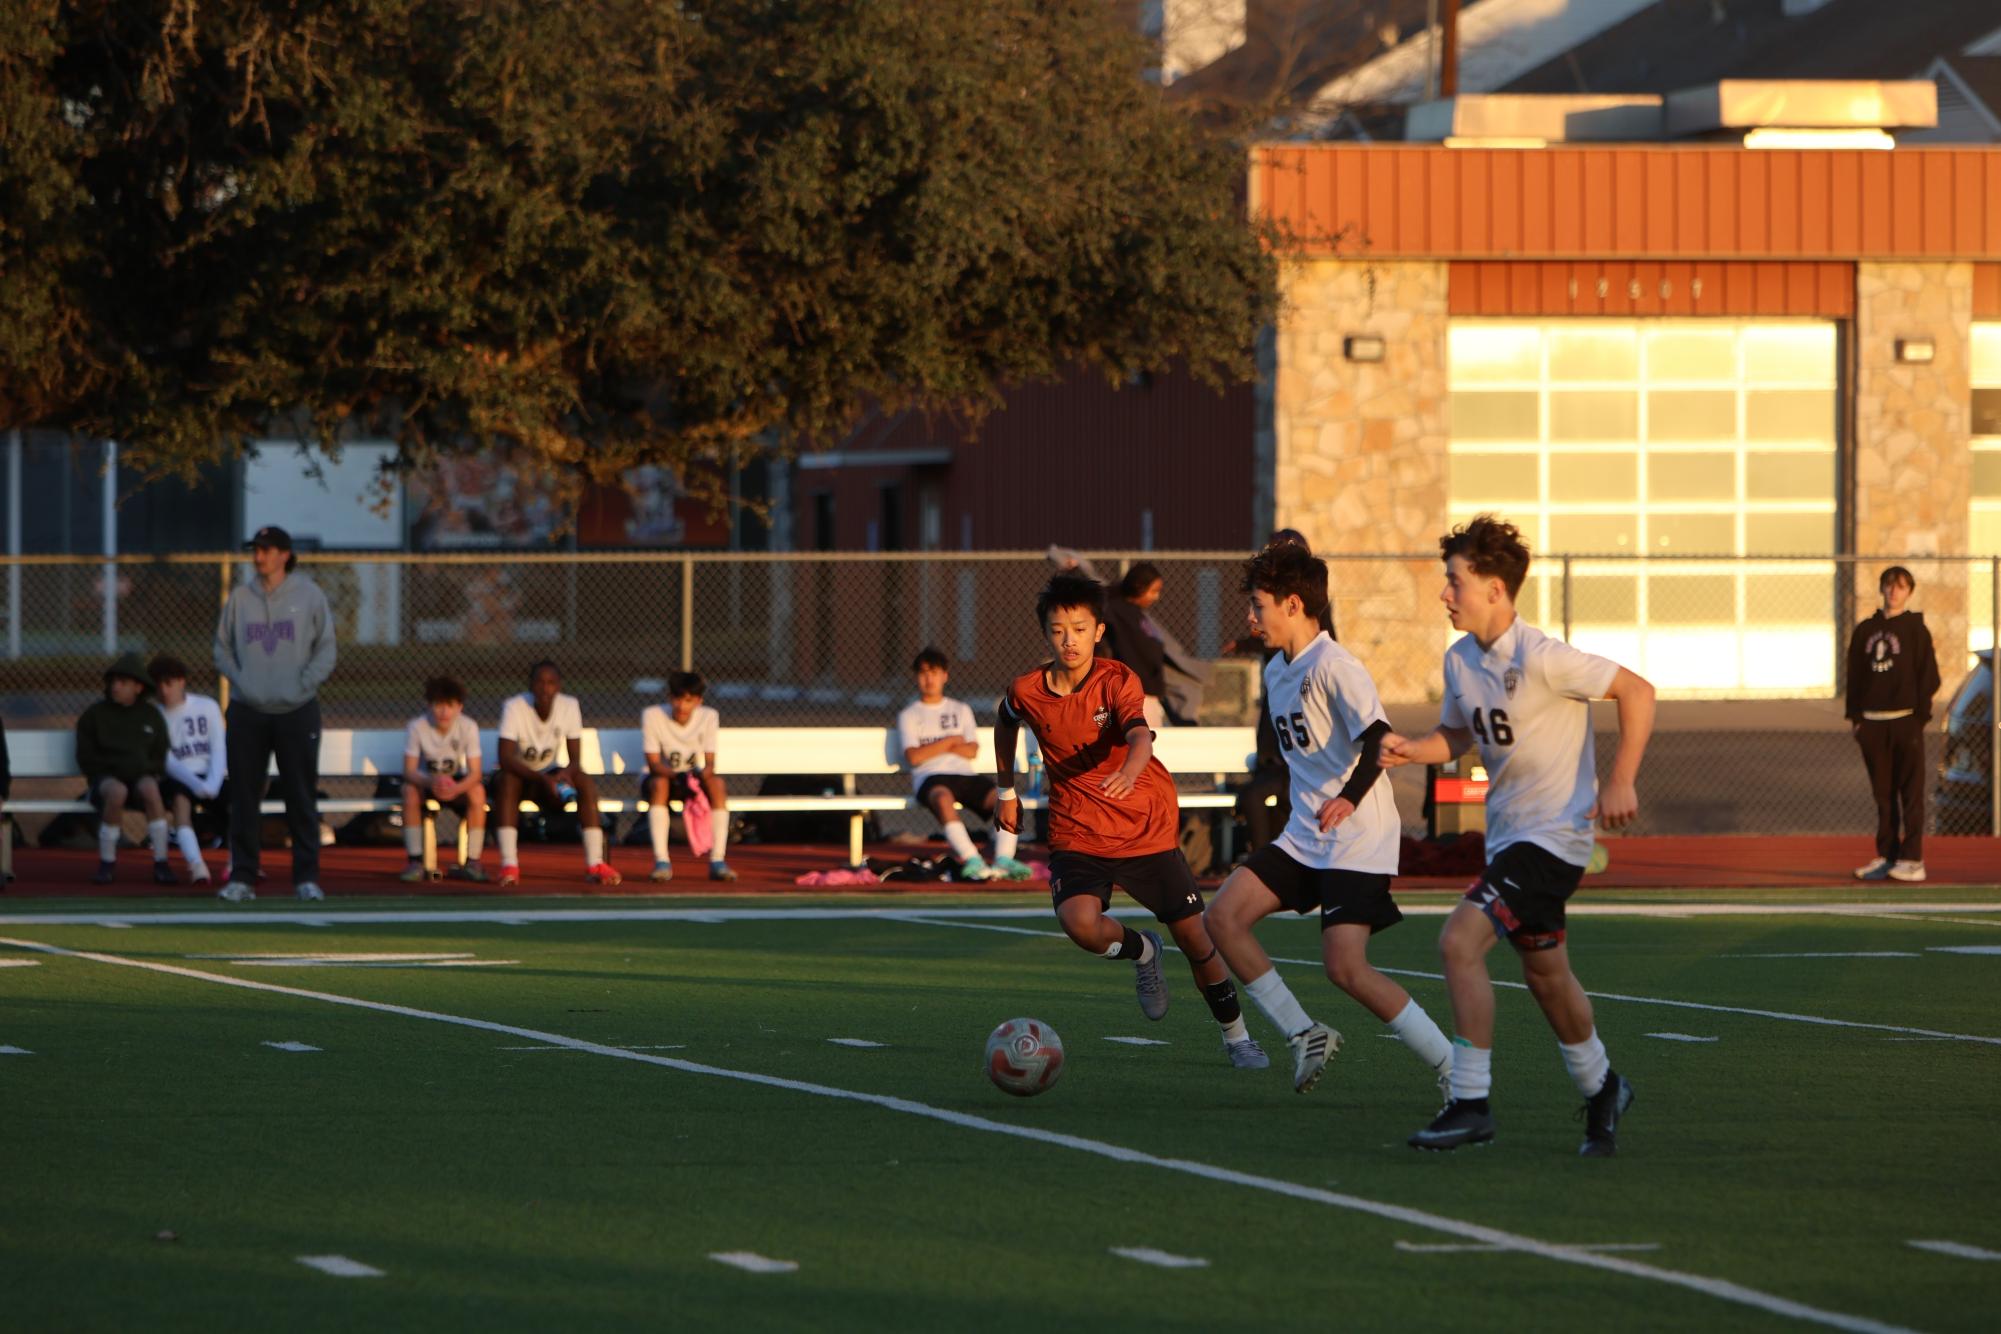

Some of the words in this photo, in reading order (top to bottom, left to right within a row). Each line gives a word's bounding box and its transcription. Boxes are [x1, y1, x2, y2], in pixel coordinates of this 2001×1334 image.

[184, 714, 209, 737] 38
[940, 713, 958, 730] 21
[1275, 711, 1311, 752] 65
[1472, 706, 1516, 746] 46
